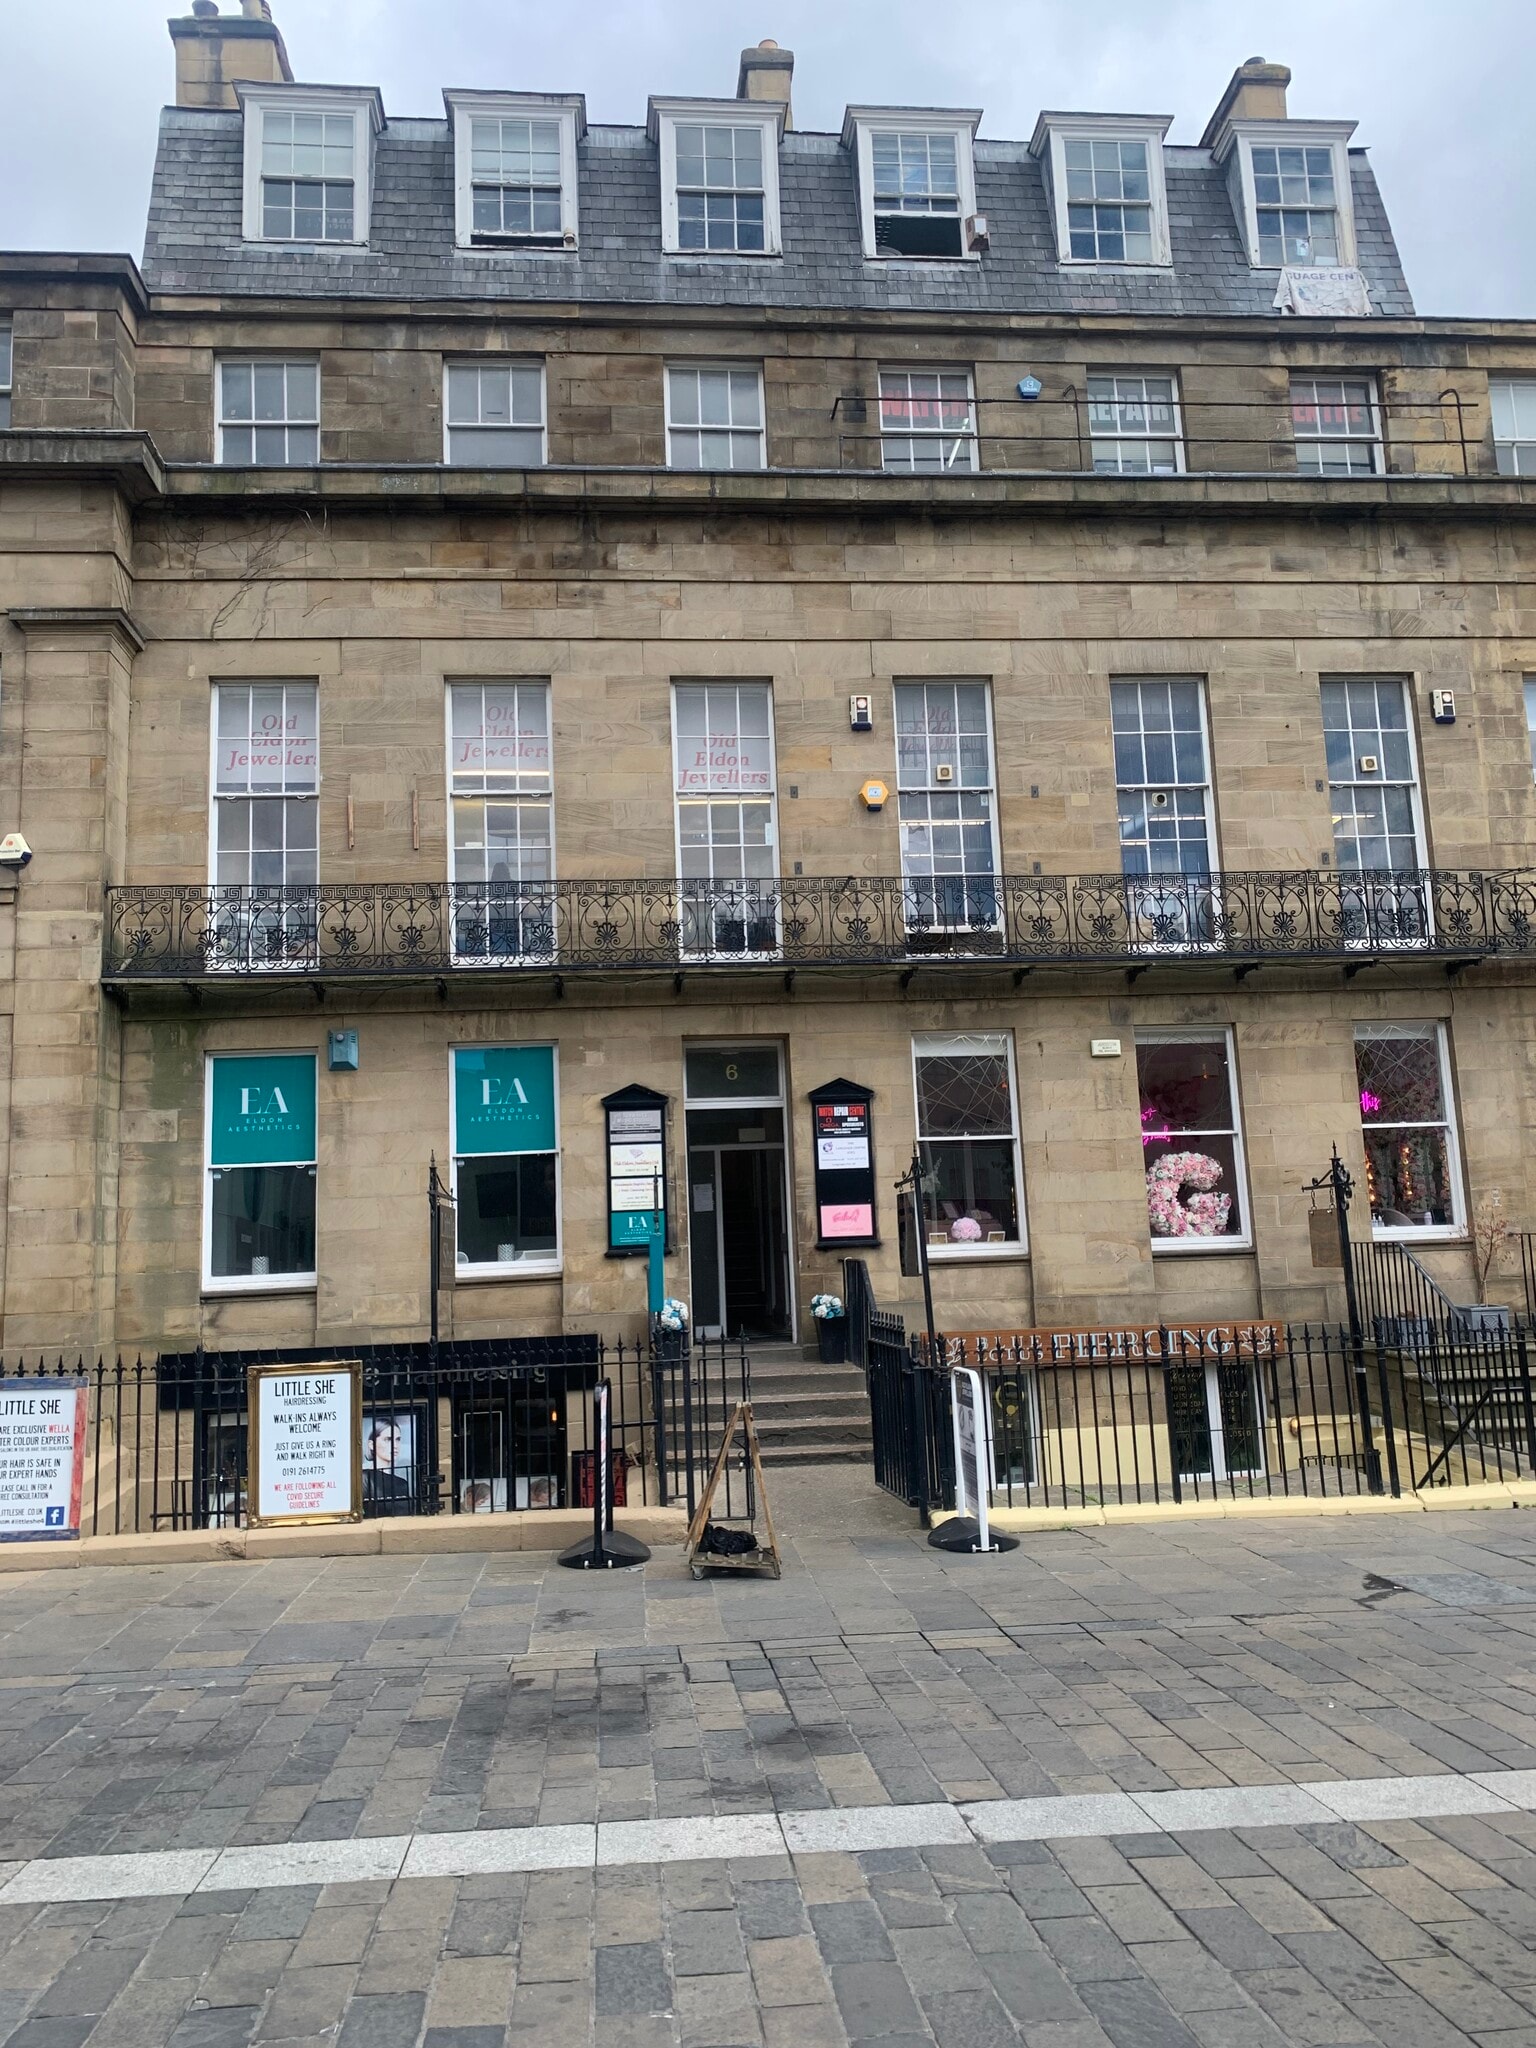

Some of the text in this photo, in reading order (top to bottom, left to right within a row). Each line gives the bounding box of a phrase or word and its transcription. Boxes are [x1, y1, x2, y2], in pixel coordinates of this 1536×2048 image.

[882, 390, 1364, 423] WATCH REPAIR ENTRE
[486, 705, 521, 721] Old
[261, 714, 298, 730] Old
[250, 731, 308, 747] Eldon
[703, 732, 737, 748] Old
[694, 751, 751, 767] Eldon
[677, 768, 768, 789] Jewellers
[725, 1064, 739, 1081] 6
[479, 1077, 530, 1105] EA
[238, 1086, 291, 1115] EA
[1360, 1091, 1381, 1112] this
[470, 1114, 540, 1122] AESTHETICS
[227, 1124, 301, 1132] AESTHETICS
[628, 1215, 648, 1229] EA
[1050, 1327, 1234, 1359] PIERCING
[274, 1379, 336, 1397] LITTLE SHE
[40, 1399, 61, 1415] SHE
[283, 1396, 327, 1407] HAIRDRESSING
[273, 1411, 337, 1424] WALK-INS ALWAYS
[13, 1424, 47, 1435] EXCLUSIVE
[48, 1424, 70, 1434] WELLA
[289, 1422, 322, 1434] WELCOME
[13, 1436, 40, 1446] COLOUR
[41, 1435, 70, 1445] EXPERTS
[274, 1439, 336, 1451] JUST GIVE US A RING
[276, 1449, 335, 1461] AND WALK RIGHT IN
[10, 1459, 26, 1468] HAIR
[27, 1458, 34, 1468] IS
[36, 1458, 51, 1468] SAFE
[54, 1458, 61, 1467] IN
[9, 1469, 34, 1479] EXPERT
[35, 1468, 58, 1479] HANDS
[282, 1465, 326, 1476] 0191 2614775
[16, 1484, 29, 1492] CALL
[31, 1483, 36, 1491] IN
[38, 1483, 48, 1491] FOR
[274, 1481, 337, 1491] WE ARE FOLLOWING ALL
[11, 1492, 49, 1501] CONSULTATION
[286, 1491, 325, 1501] COVID SECURE
[289, 1500, 320, 1510] GUIDELINES
